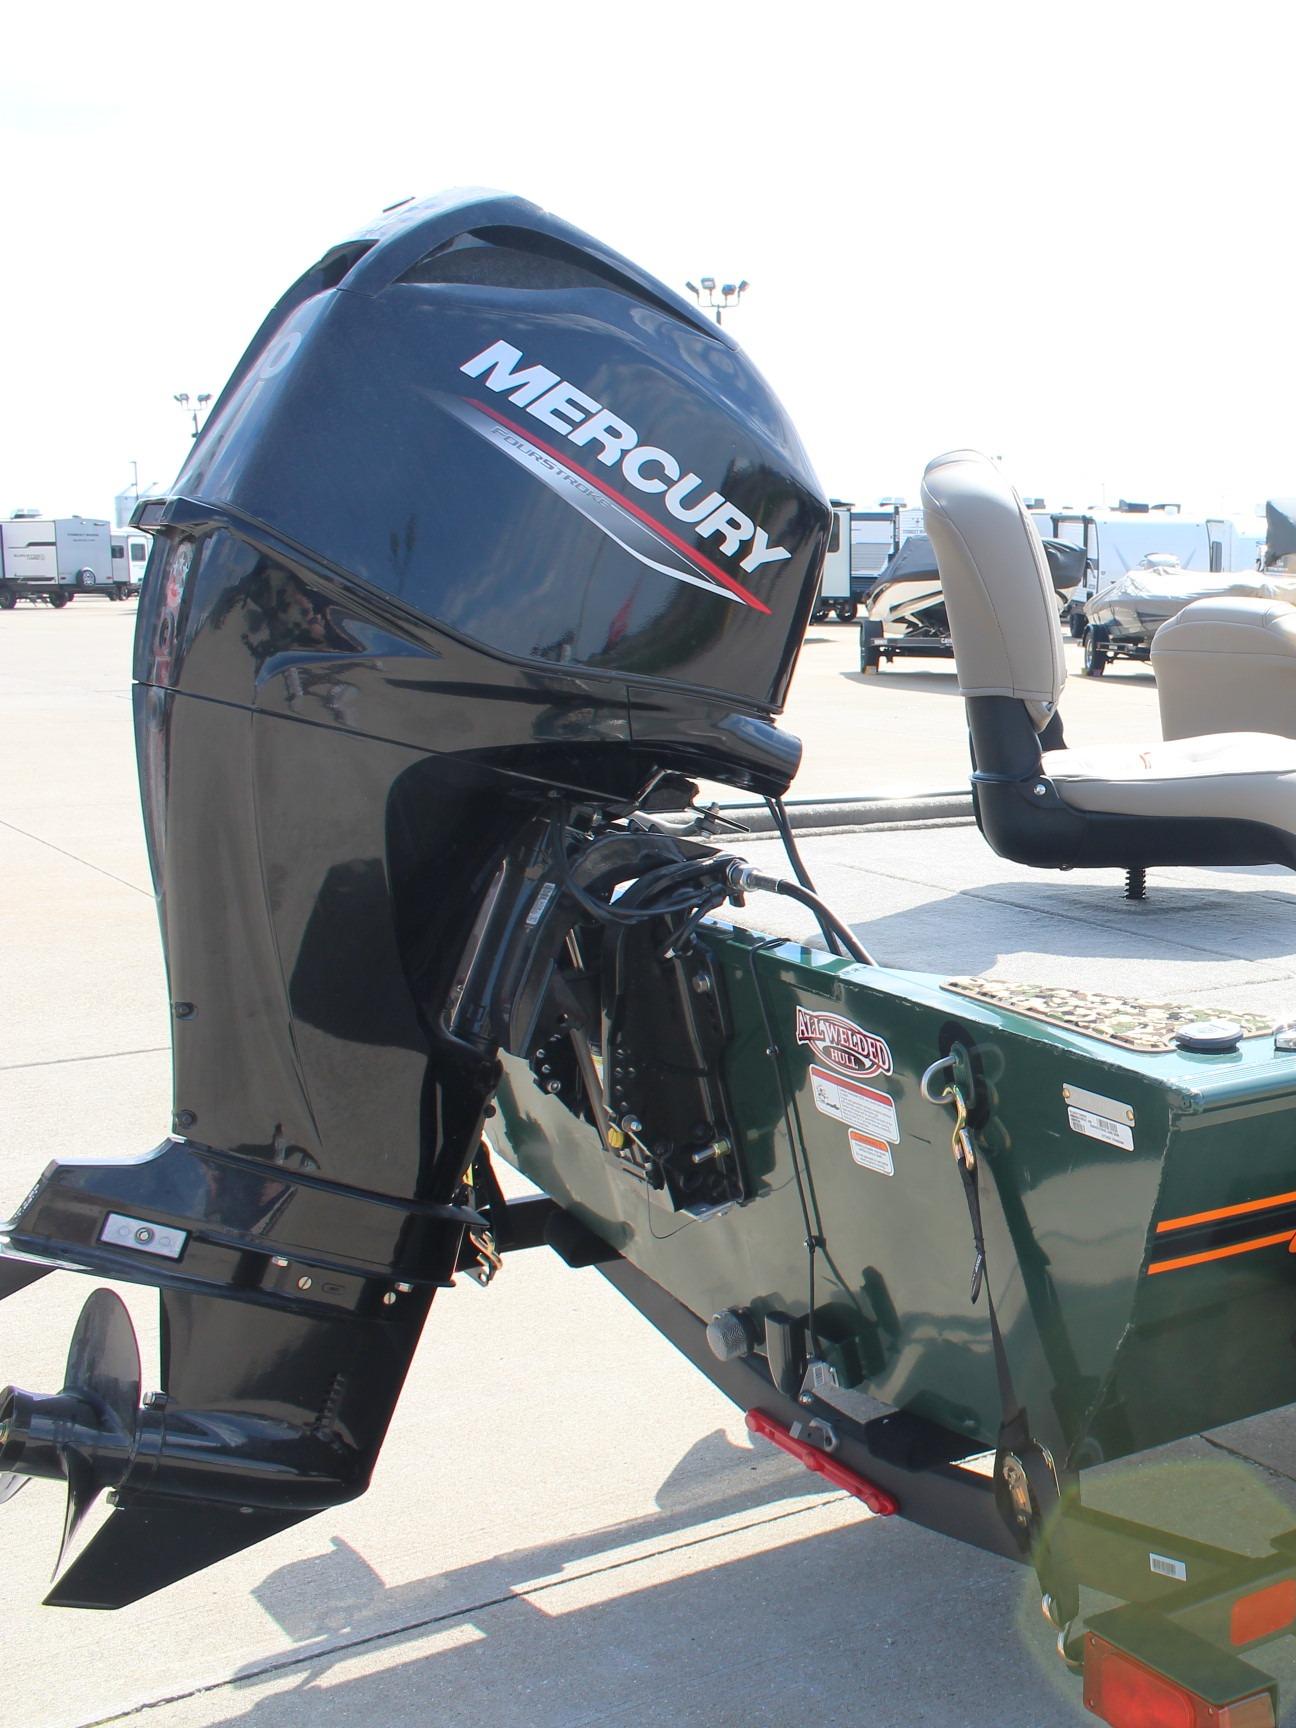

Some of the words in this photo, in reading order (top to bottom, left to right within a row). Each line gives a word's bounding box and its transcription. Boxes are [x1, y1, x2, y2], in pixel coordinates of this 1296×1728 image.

[459, 339, 792, 574] MERCURY
[490, 426, 613, 510] FOURSTROKE
[798, 1010, 825, 1039] ALL
[825, 1021, 889, 1070] WELDED
[830, 1048, 859, 1069] HULL
